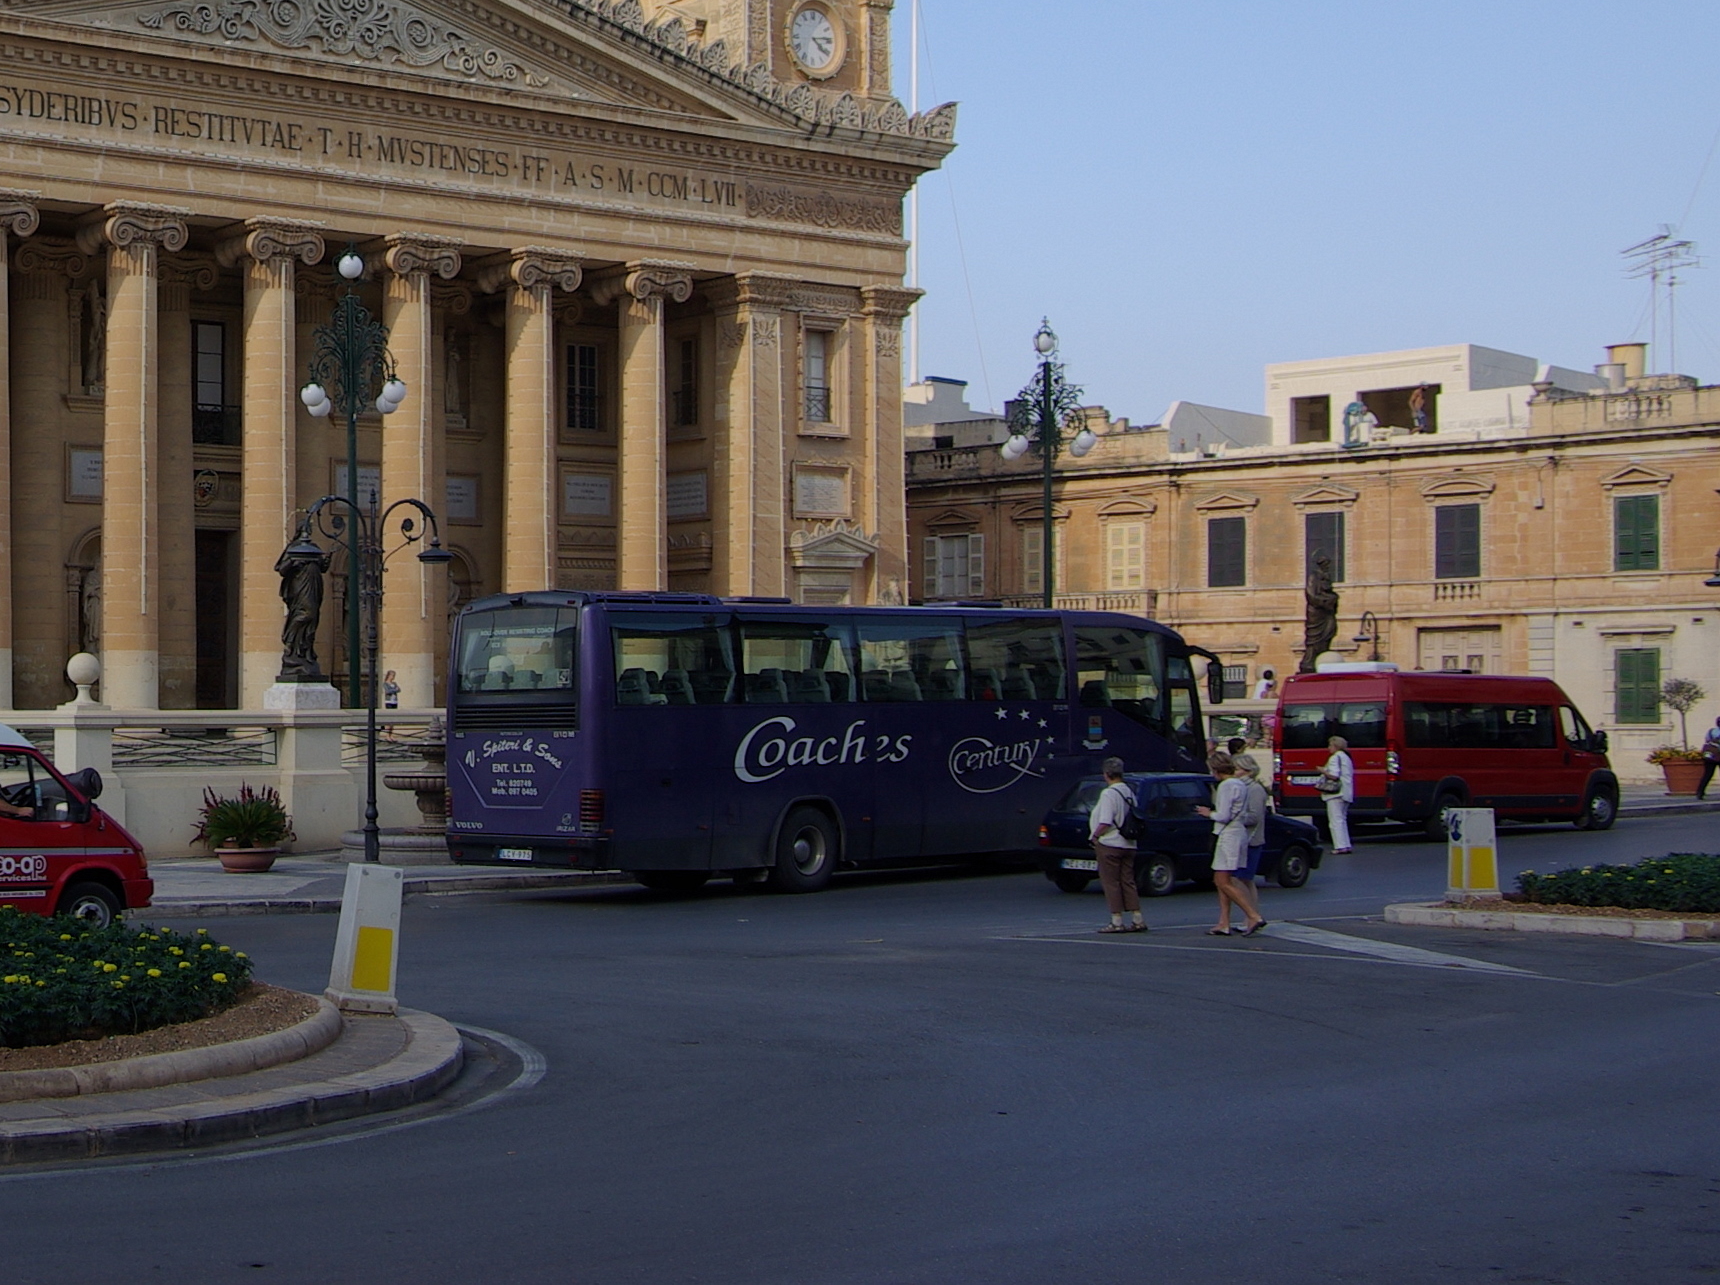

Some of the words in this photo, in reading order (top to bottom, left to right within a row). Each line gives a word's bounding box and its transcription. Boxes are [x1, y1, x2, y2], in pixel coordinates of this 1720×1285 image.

[153, 105, 303, 152] RESTITVTAE
[317, 127, 333, 155] T
[347, 130, 363, 159] H
[377, 135, 509, 179] MVSTENSES
[522, 154, 550, 183] FF
[563, 161, 578, 187] A
[590, 164, 604, 190] S
[617, 167, 634, 194] M
[482, 738, 521, 758] Spiteri
[522, 737, 534, 752] &
[535, 743, 563, 770] Sons
[491, 763, 511, 774] ENT.
[732, 716, 915, 784] Coaches
[950, 736, 1043, 788] Century
[455, 821, 484, 830] VOLVO
